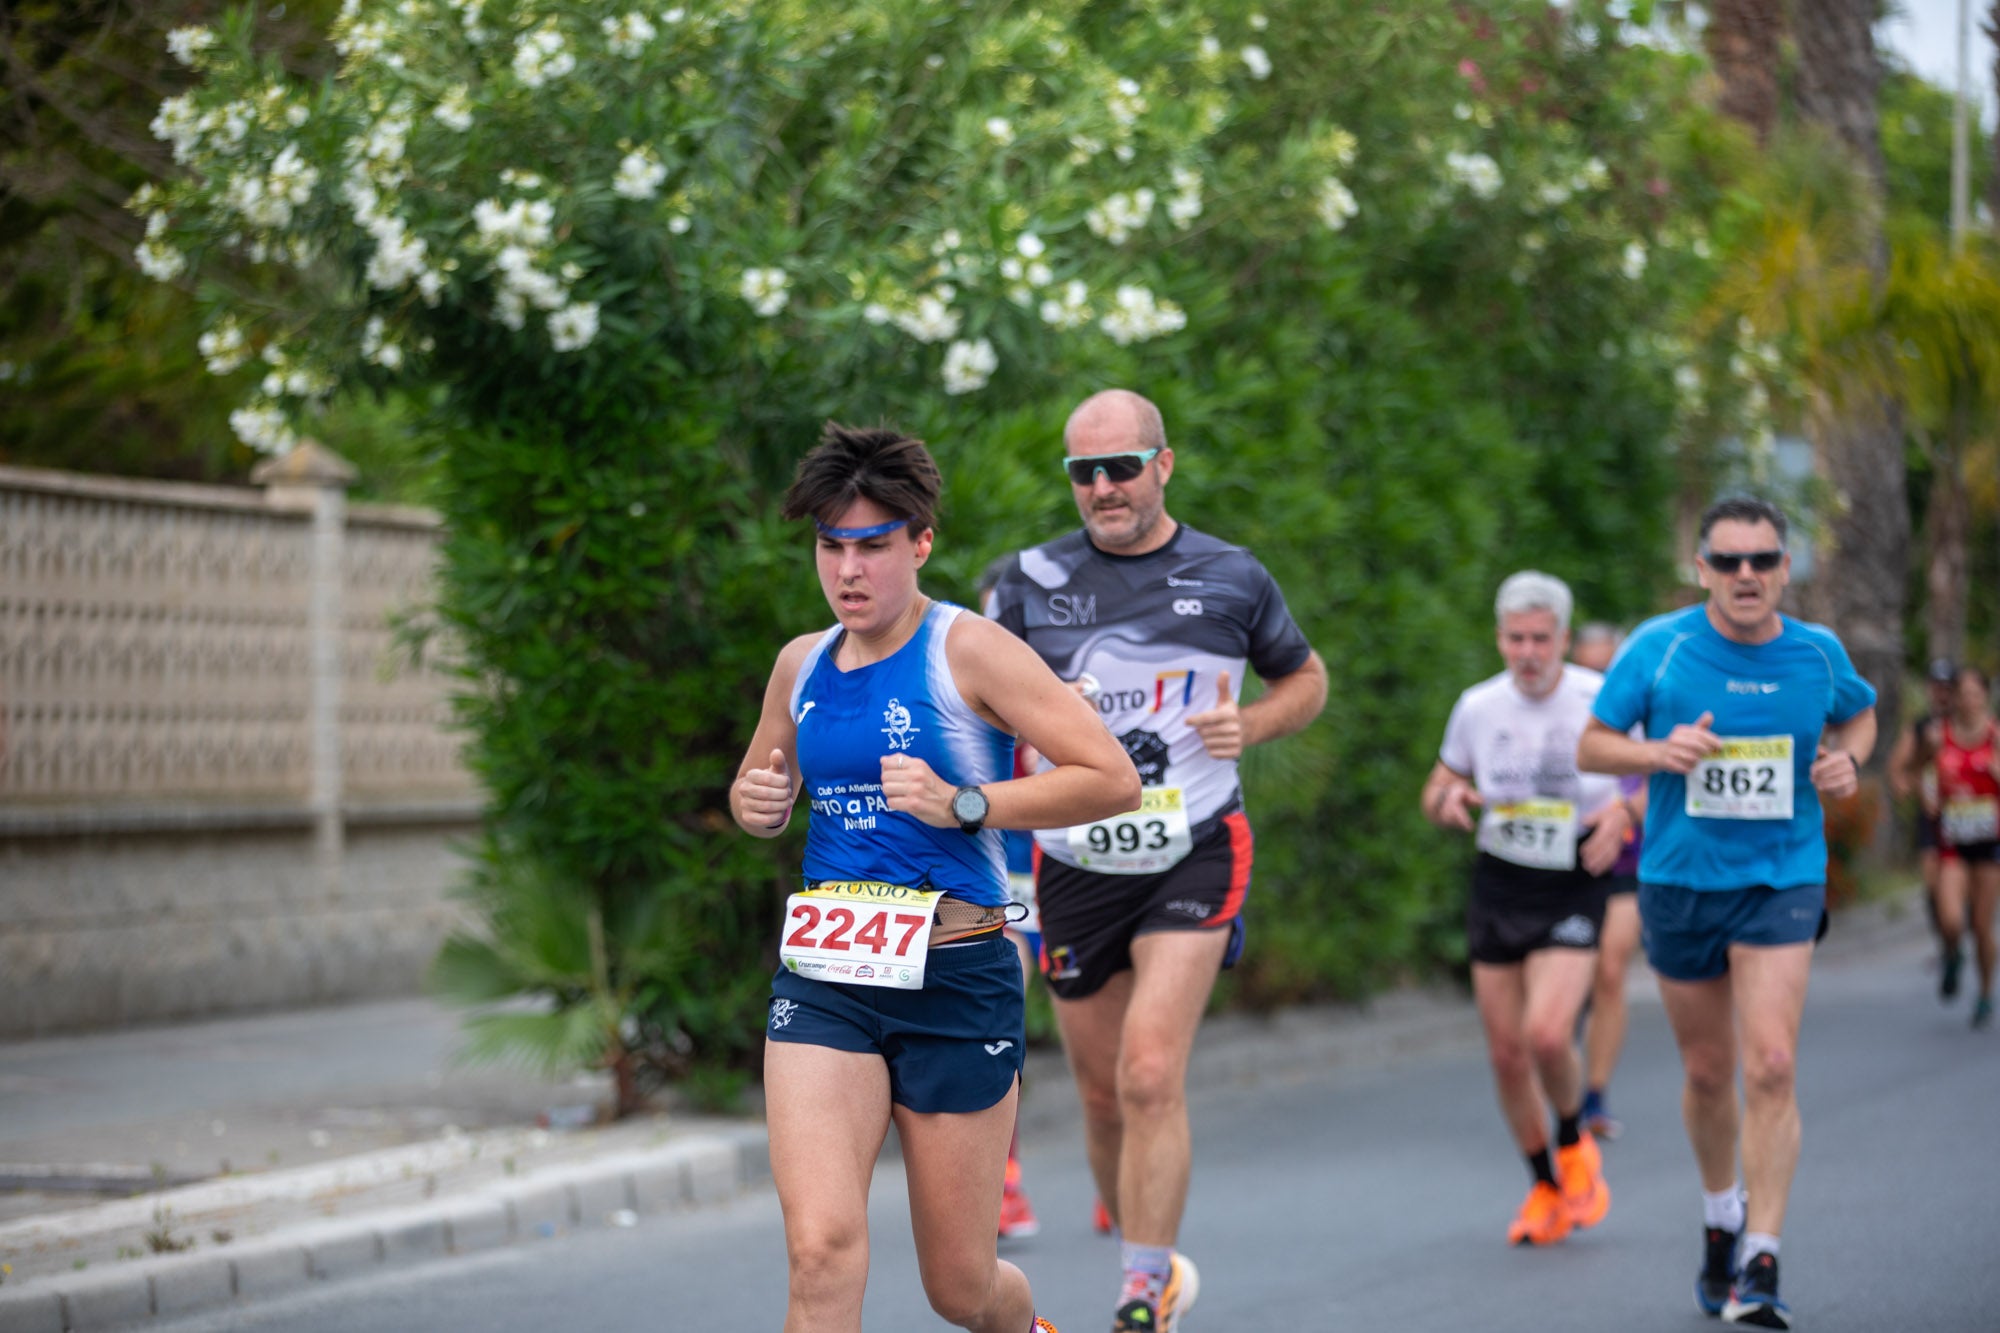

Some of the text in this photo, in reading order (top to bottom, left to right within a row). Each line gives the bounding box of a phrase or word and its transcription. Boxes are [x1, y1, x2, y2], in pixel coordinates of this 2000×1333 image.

[1047, 593, 1097, 626] SM
[1099, 690, 1145, 714] OTO
[817, 782, 884, 797] Club de Atletism
[1704, 767, 1776, 796] 862
[846, 799, 861, 814] a
[865, 795, 897, 813] PA
[1088, 821, 1169, 854] 993
[786, 905, 926, 957] 2247
[798, 960, 827, 970] Cruzcampo
